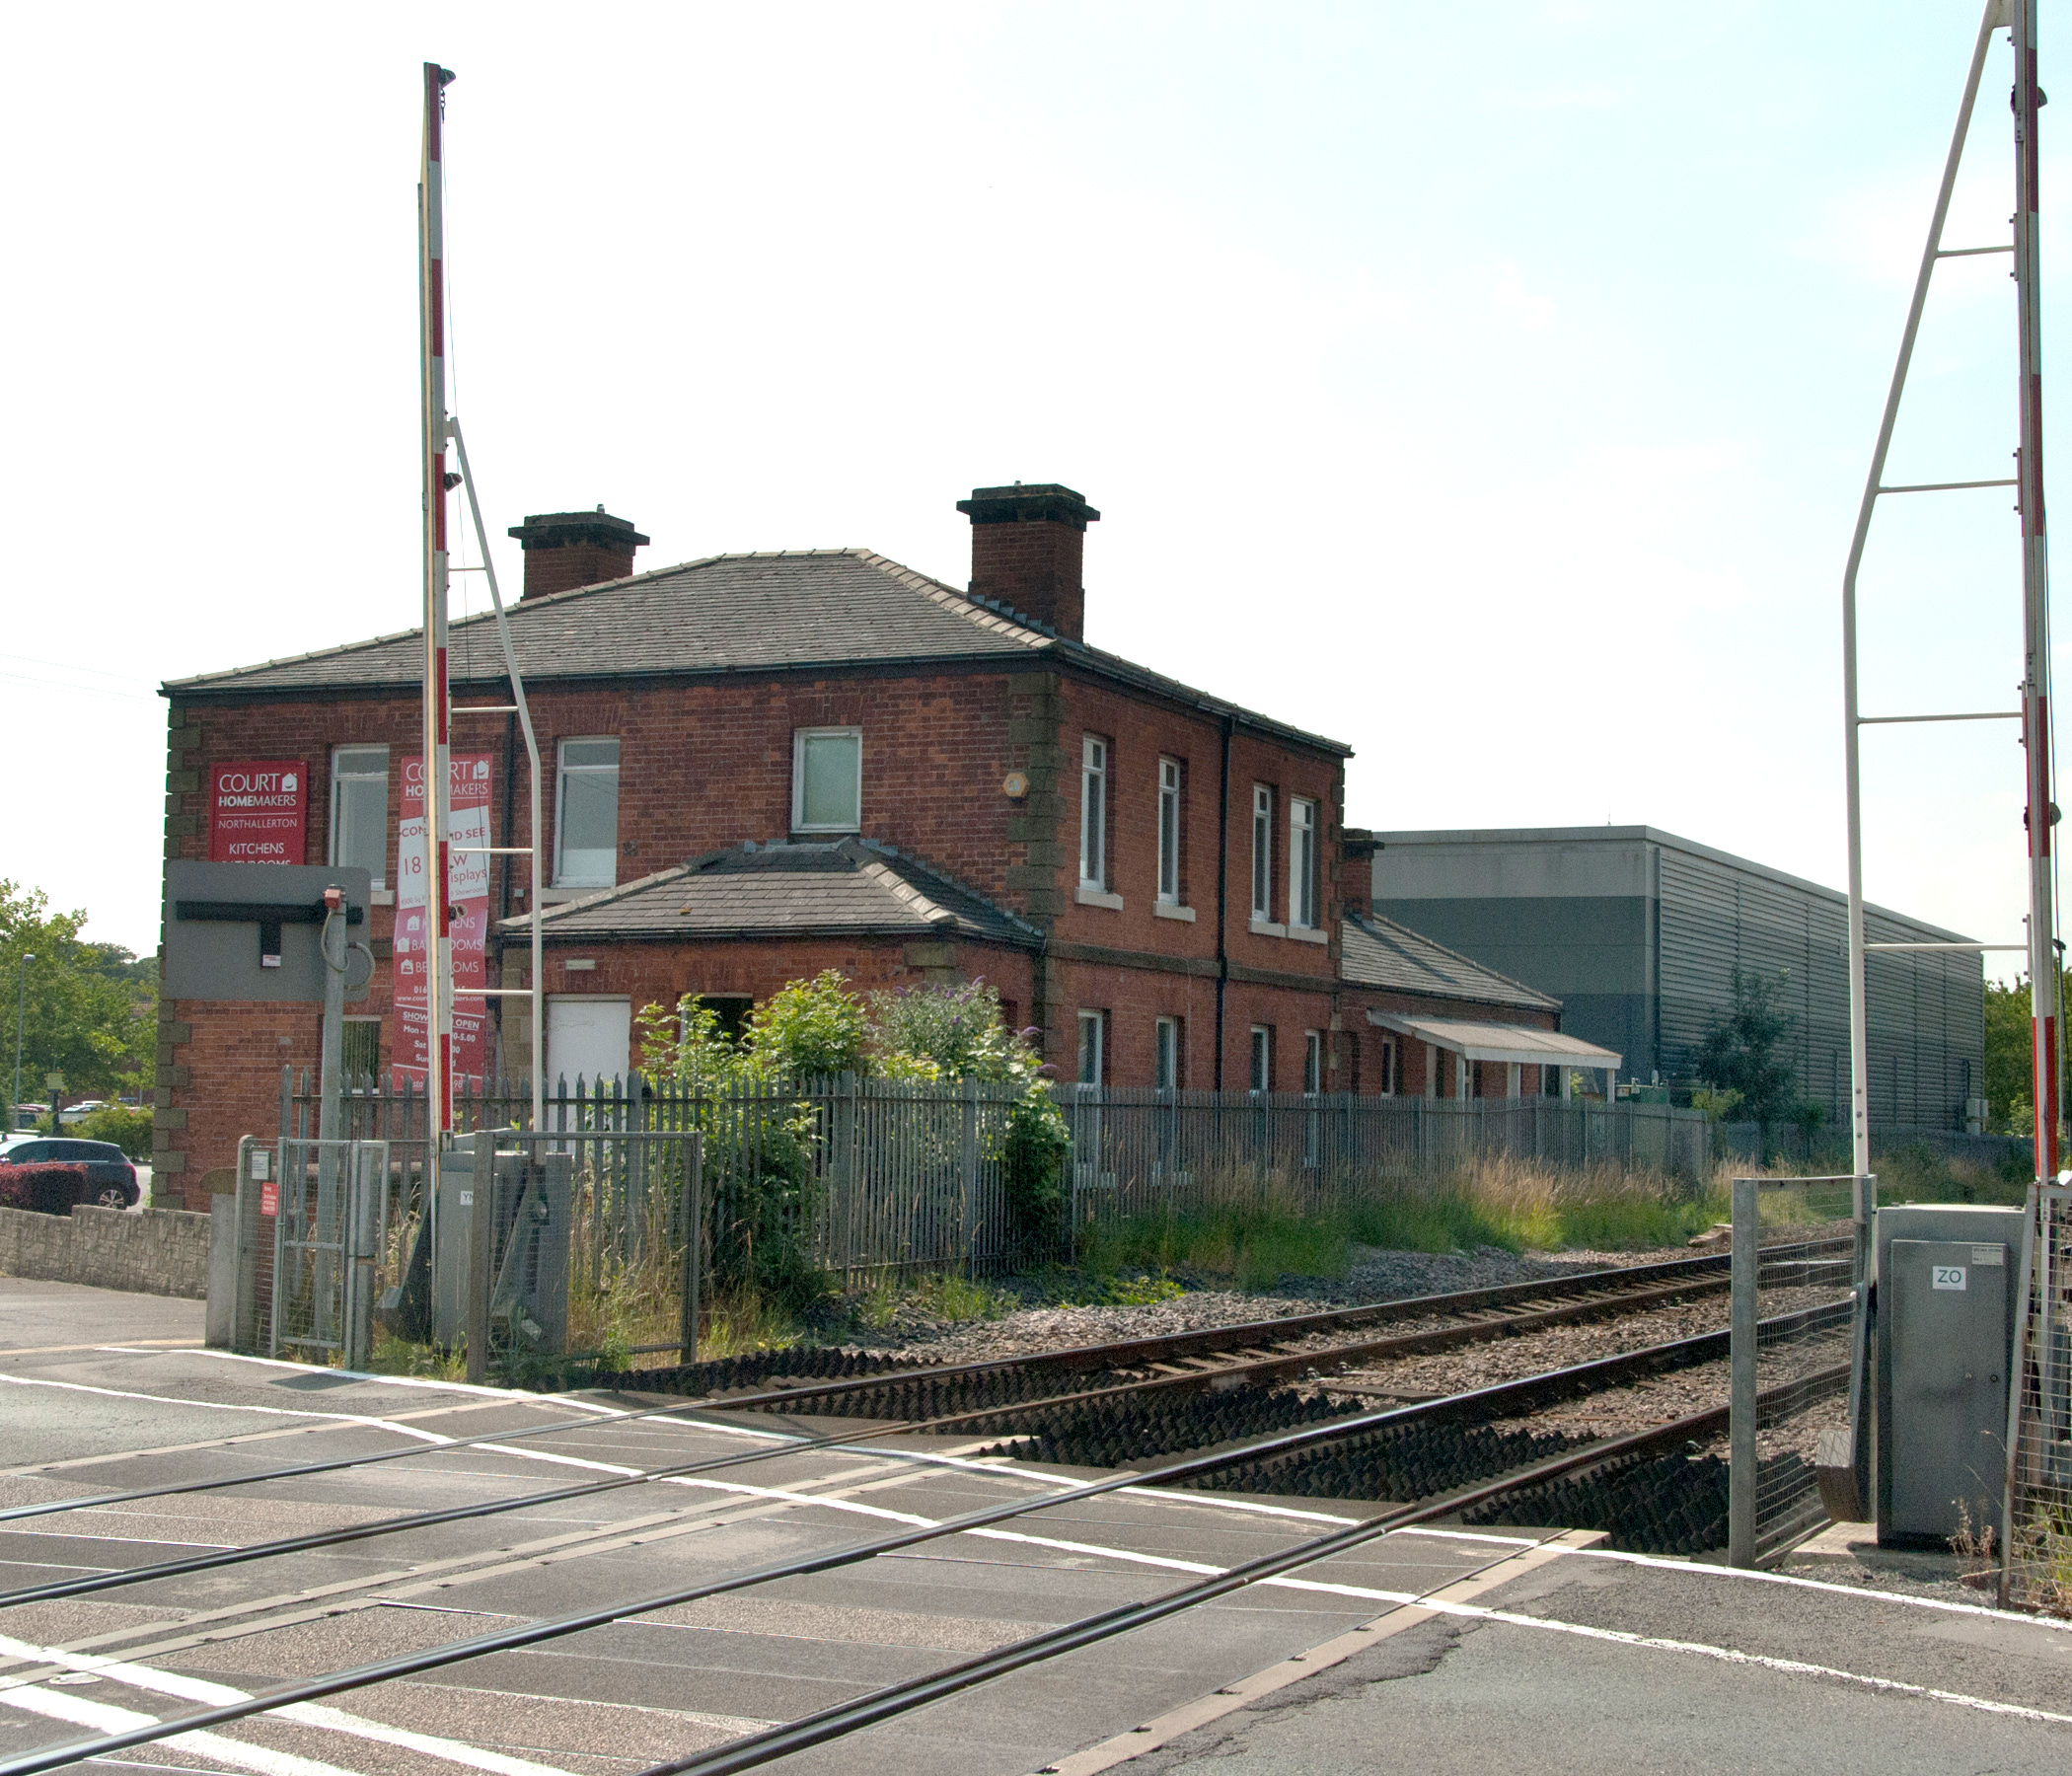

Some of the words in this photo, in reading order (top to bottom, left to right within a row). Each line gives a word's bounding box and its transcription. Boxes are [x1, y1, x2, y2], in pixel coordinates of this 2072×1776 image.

[219, 774, 280, 792] COURT
[218, 794, 297, 807] HOMEMAKERS
[218, 818, 297, 829] NORTHALLERTON
[465, 827, 486, 839] SEE
[229, 843, 284, 854] KITCHENS
[405, 855, 421, 875] 18
[404, 1024, 419, 1034] Mon
[455, 1018, 480, 1029] OPEN
[414, 1040, 426, 1049] Sat
